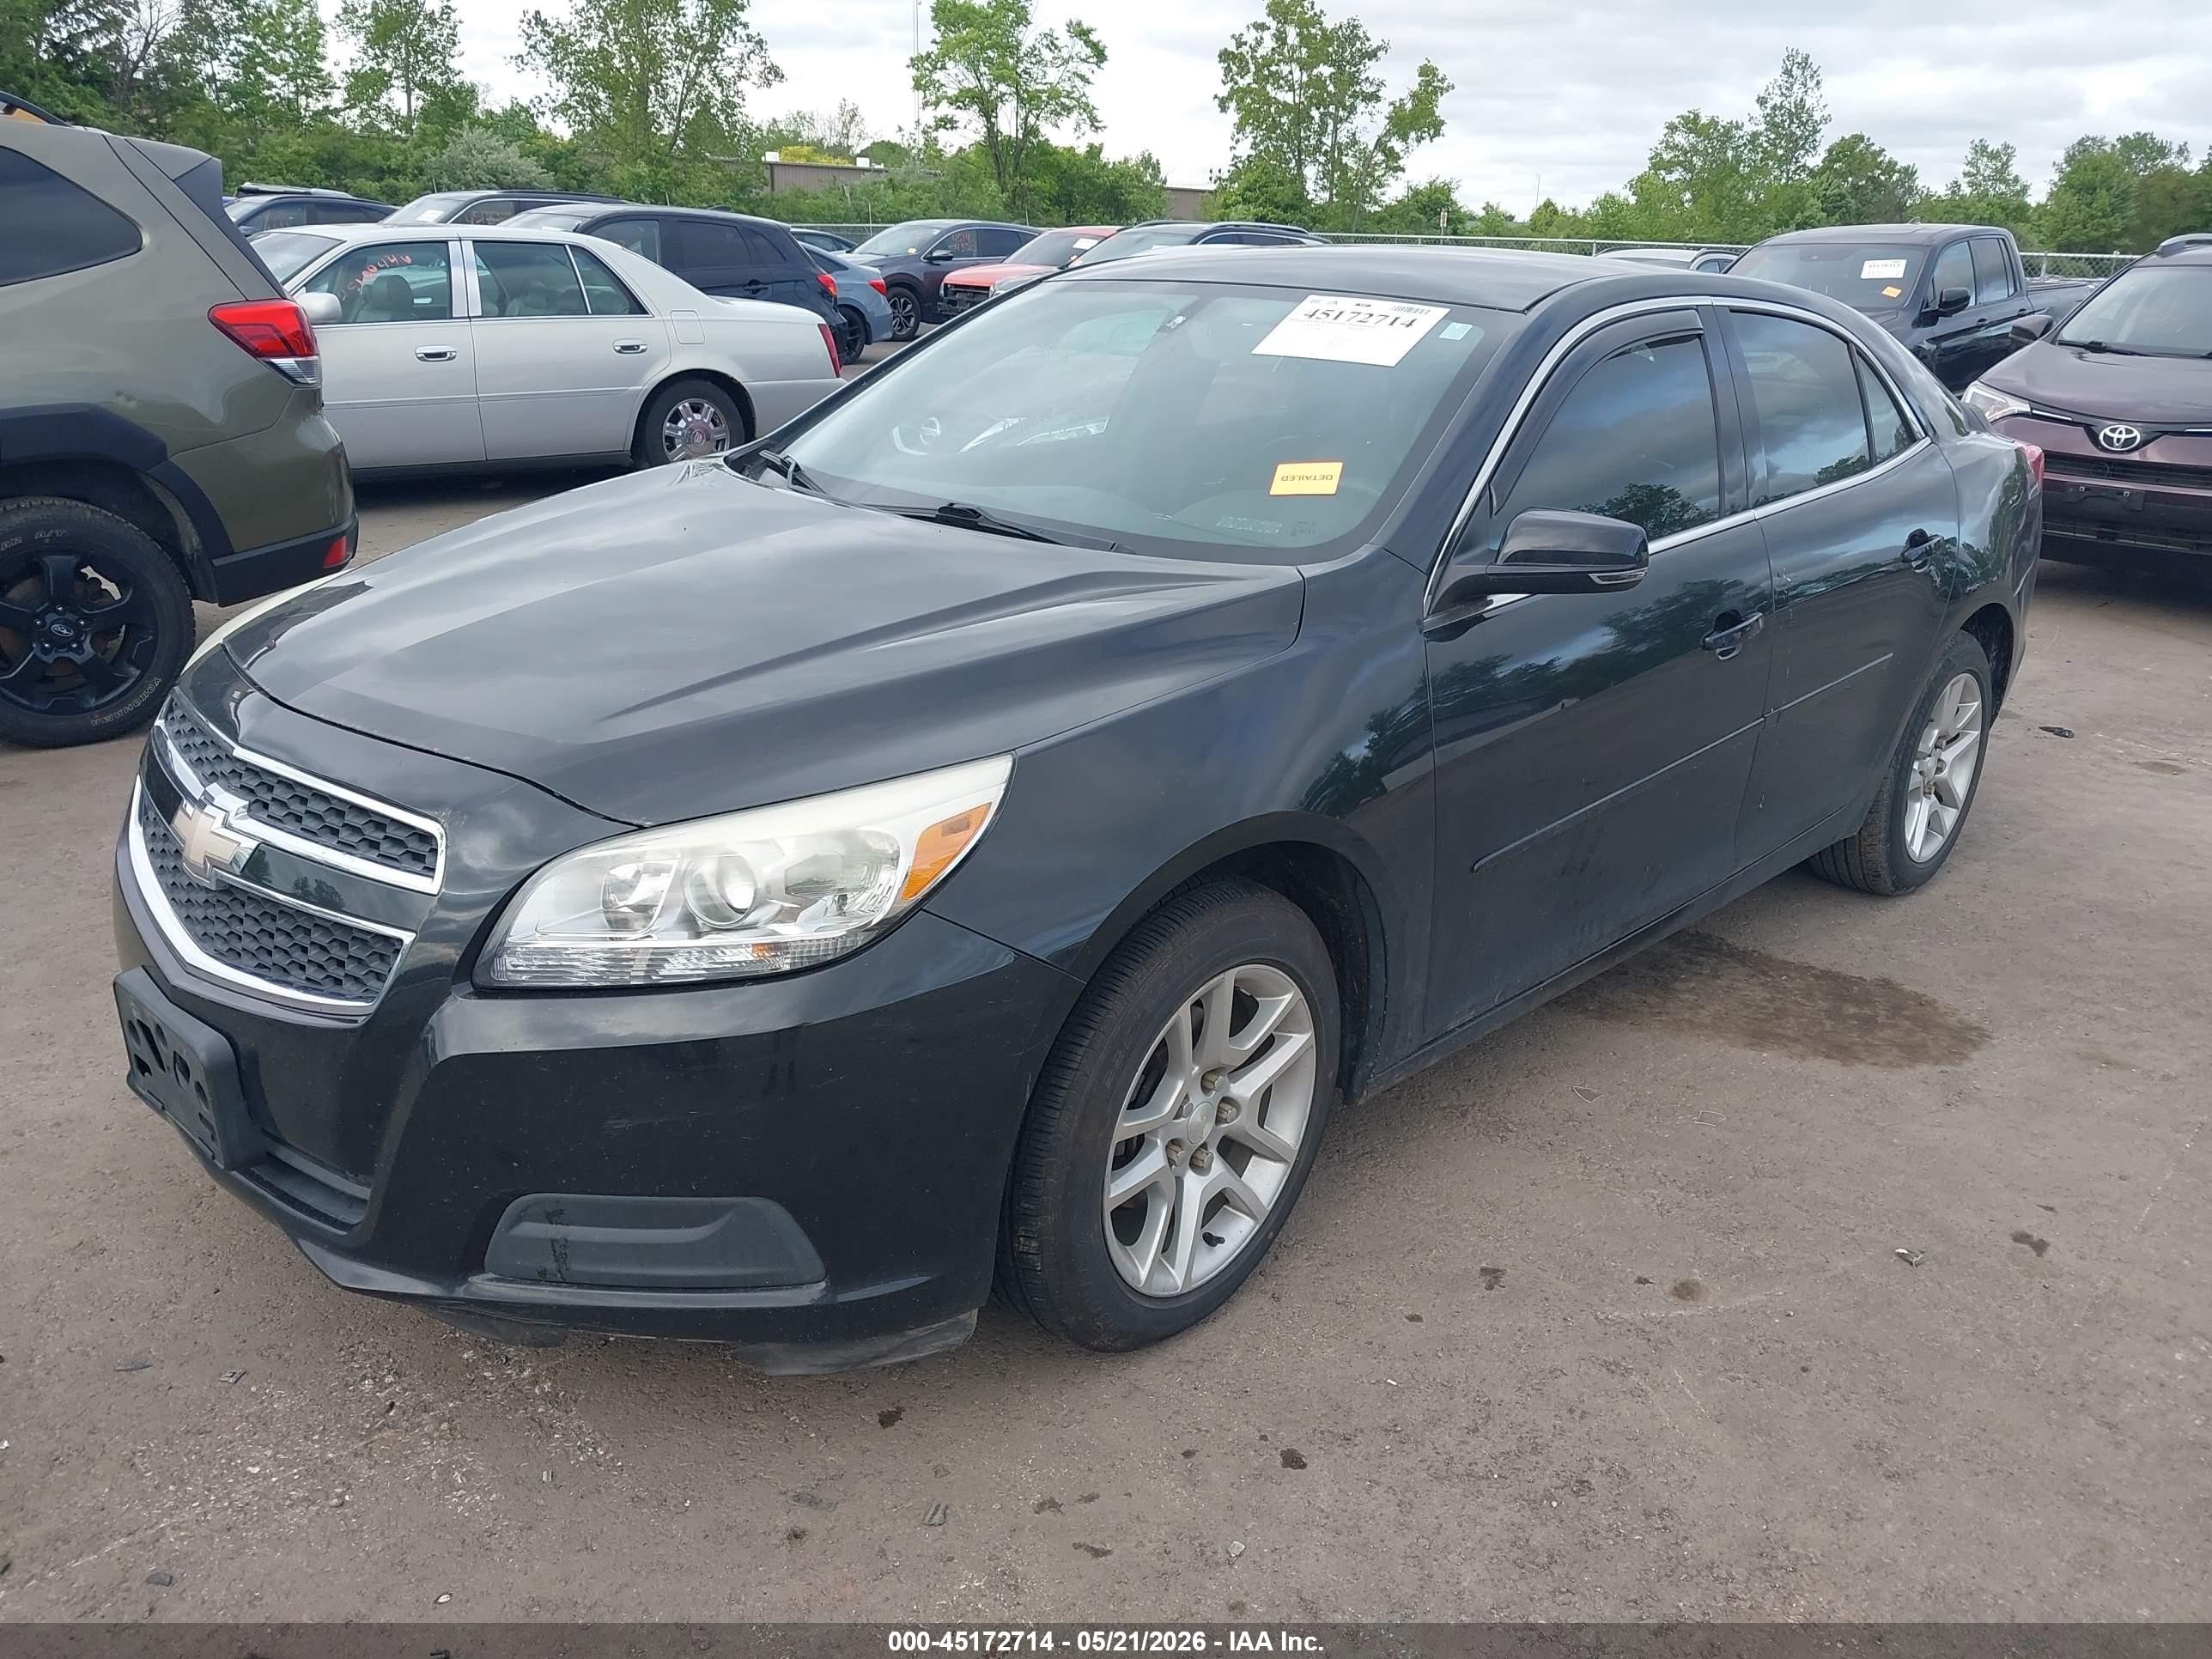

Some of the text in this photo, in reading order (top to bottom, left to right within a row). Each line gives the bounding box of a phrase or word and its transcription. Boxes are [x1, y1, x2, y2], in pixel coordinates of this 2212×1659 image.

[1304, 308, 1418, 328] 45172714
[1280, 473, 1334, 482] DETAILED
[90, 677, 161, 727] YOKOHAMA
